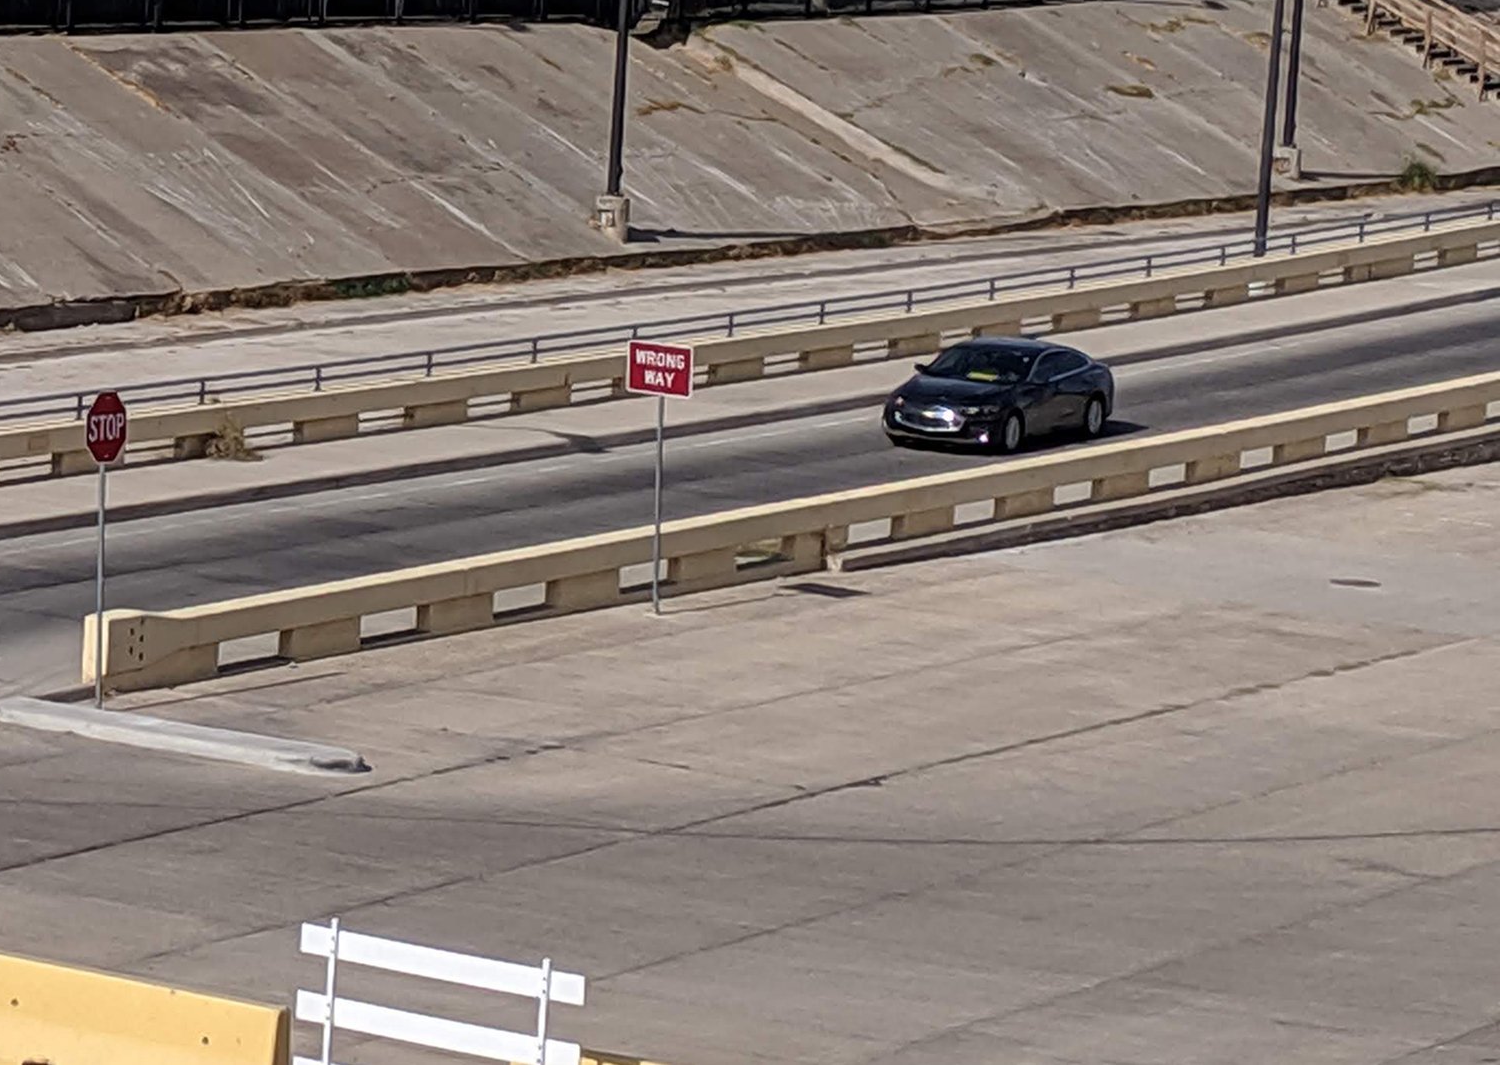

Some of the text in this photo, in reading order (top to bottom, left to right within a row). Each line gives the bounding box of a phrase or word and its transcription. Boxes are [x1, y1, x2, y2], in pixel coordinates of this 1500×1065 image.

[635, 349, 685, 370] WRONG
[644, 370, 675, 388] WAY
[88, 413, 125, 443] STOP
